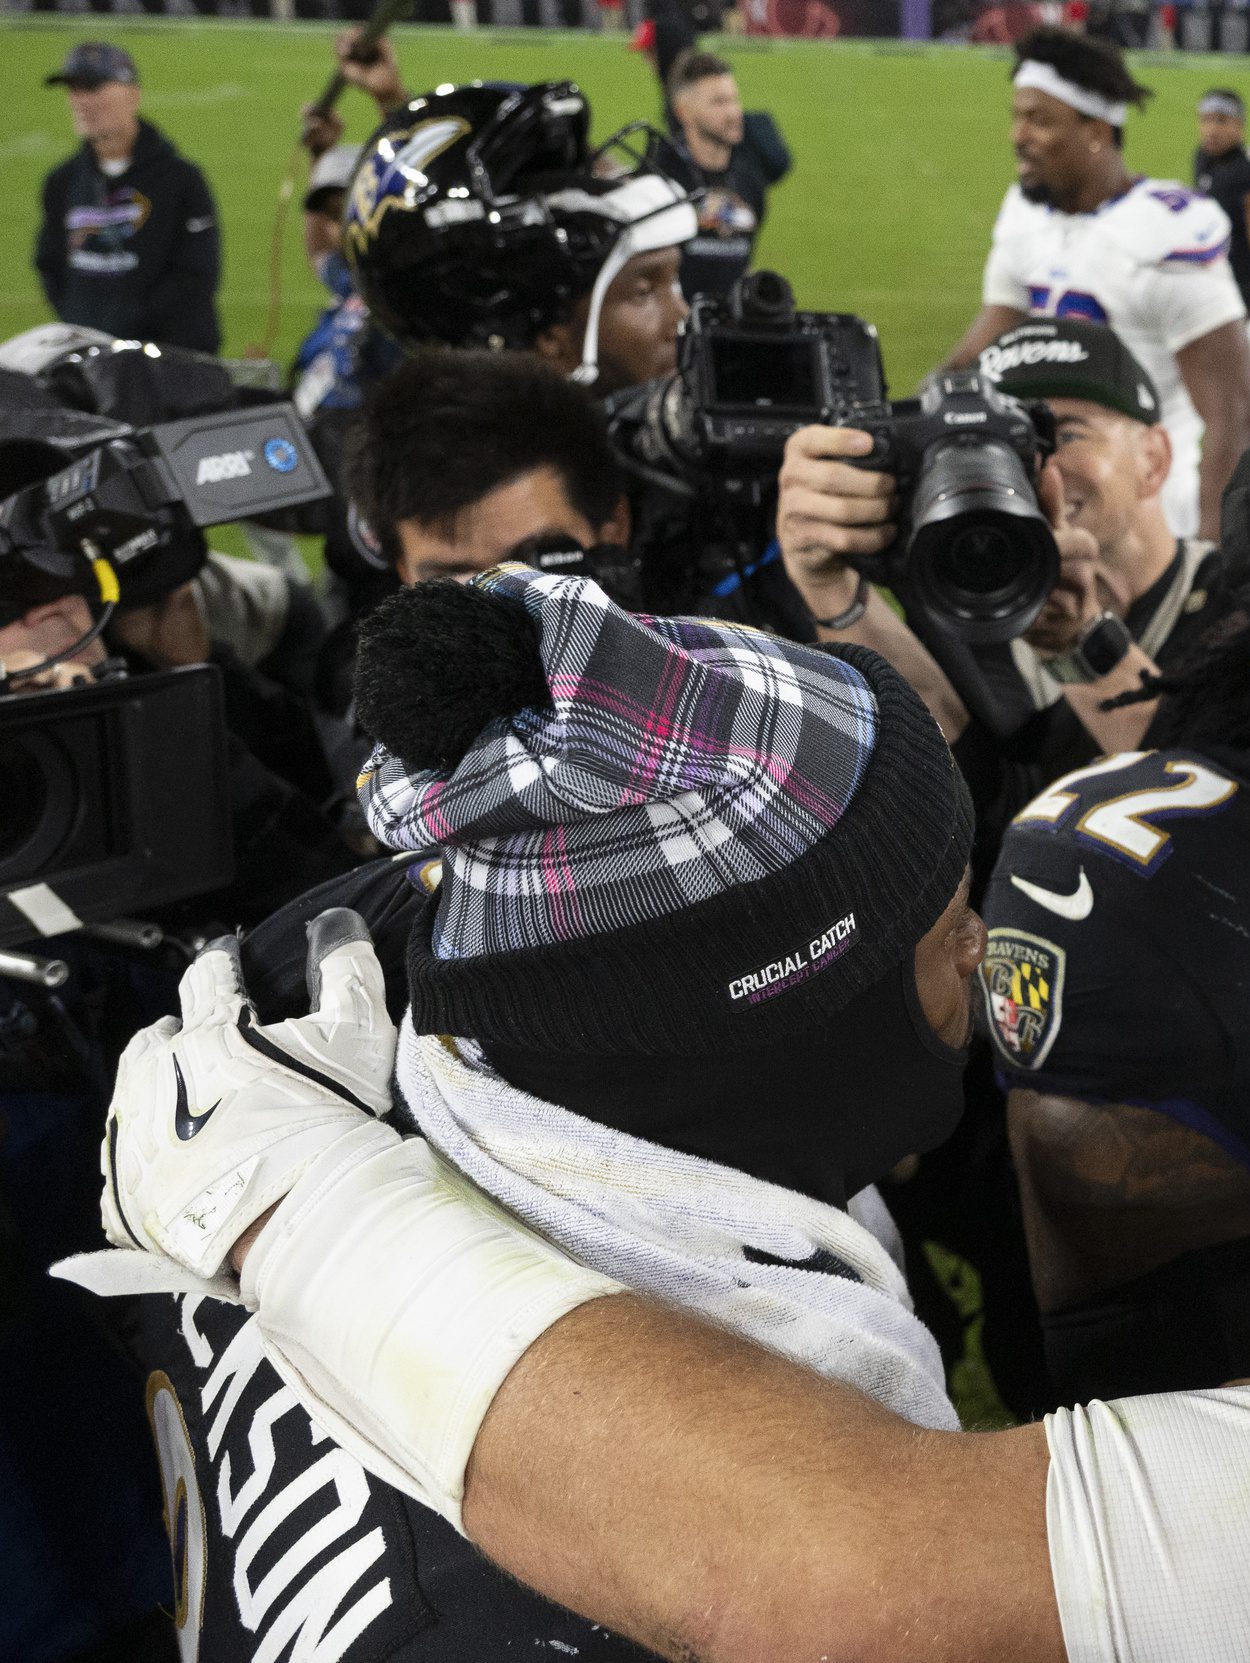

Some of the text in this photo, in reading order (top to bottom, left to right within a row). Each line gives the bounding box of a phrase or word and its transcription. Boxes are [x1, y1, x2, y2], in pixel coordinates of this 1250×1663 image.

[979, 340, 1090, 383] Ravens
[943, 411, 988, 425] Canon
[1011, 750, 1240, 879] 22
[728, 912, 856, 1000] CRUCIAL CATCH
[747, 937, 850, 1005] INTERCEPT CANCER
[987, 941, 1050, 970] RAVENS
